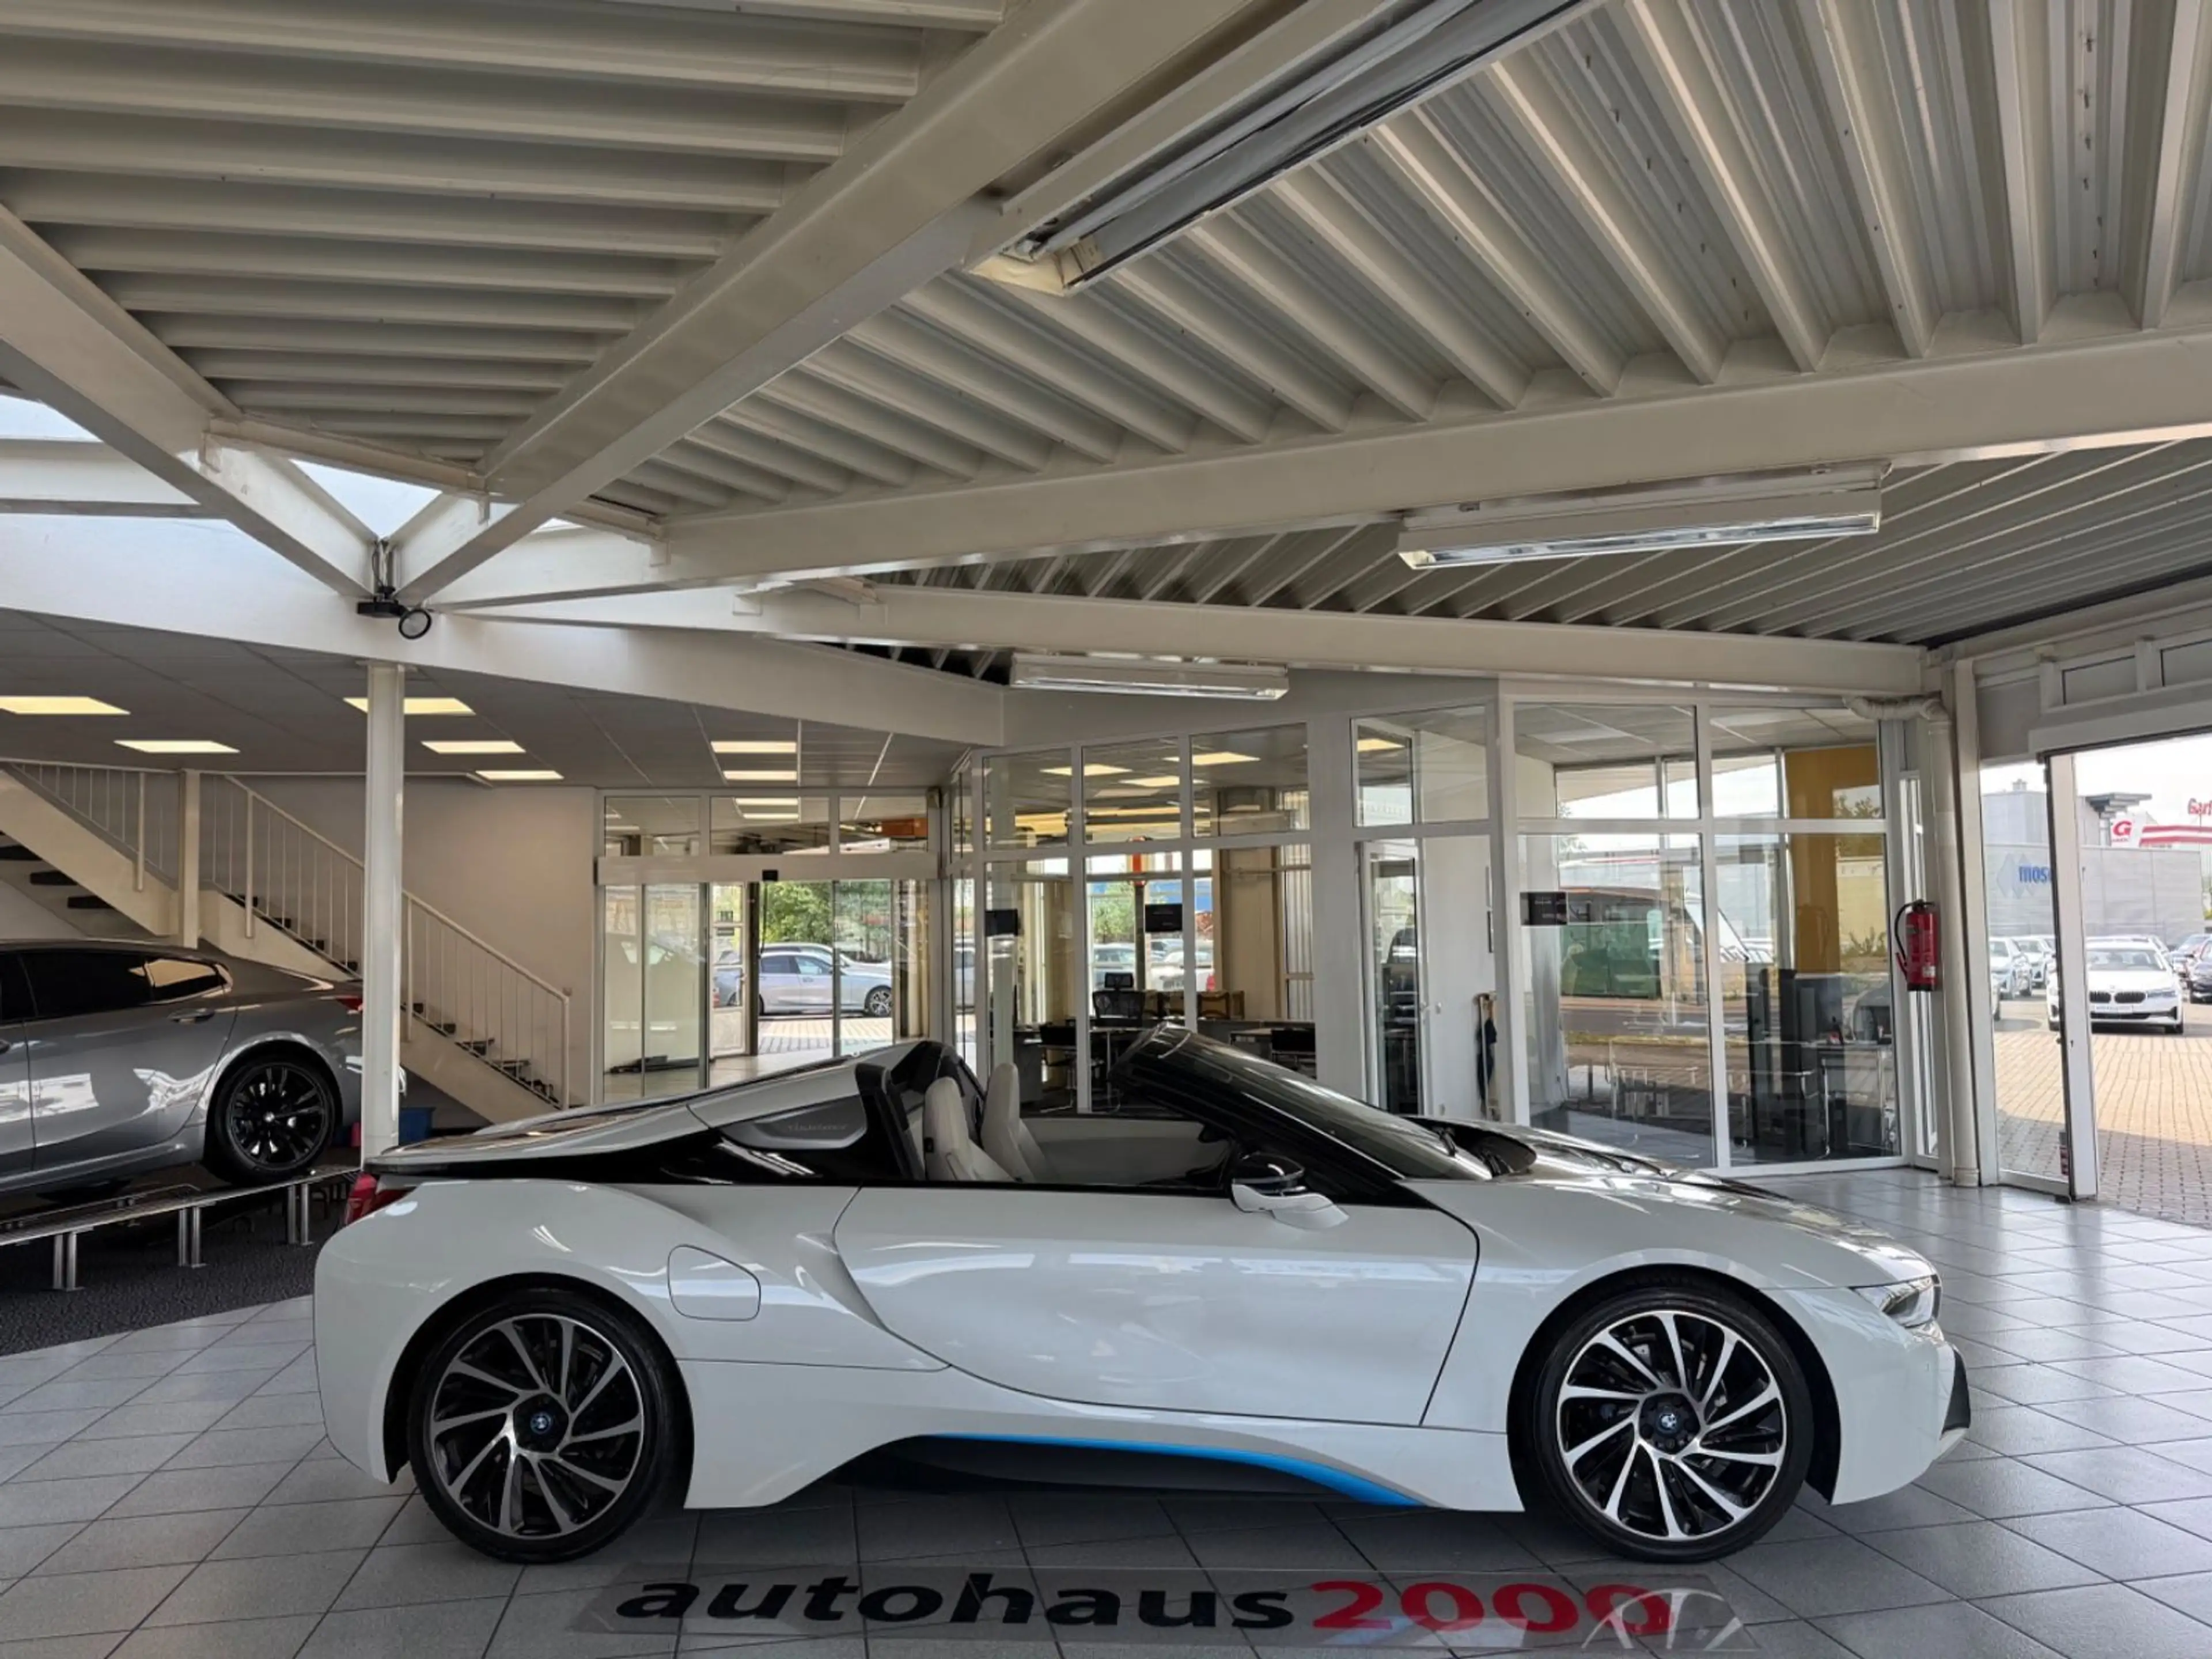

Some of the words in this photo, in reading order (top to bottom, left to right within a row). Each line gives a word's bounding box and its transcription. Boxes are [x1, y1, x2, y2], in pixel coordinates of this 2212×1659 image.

[2113, 820, 2132, 836] G
[2018, 866, 2051, 884] mos
[616, 1573, 1672, 1635] autohaus2000
